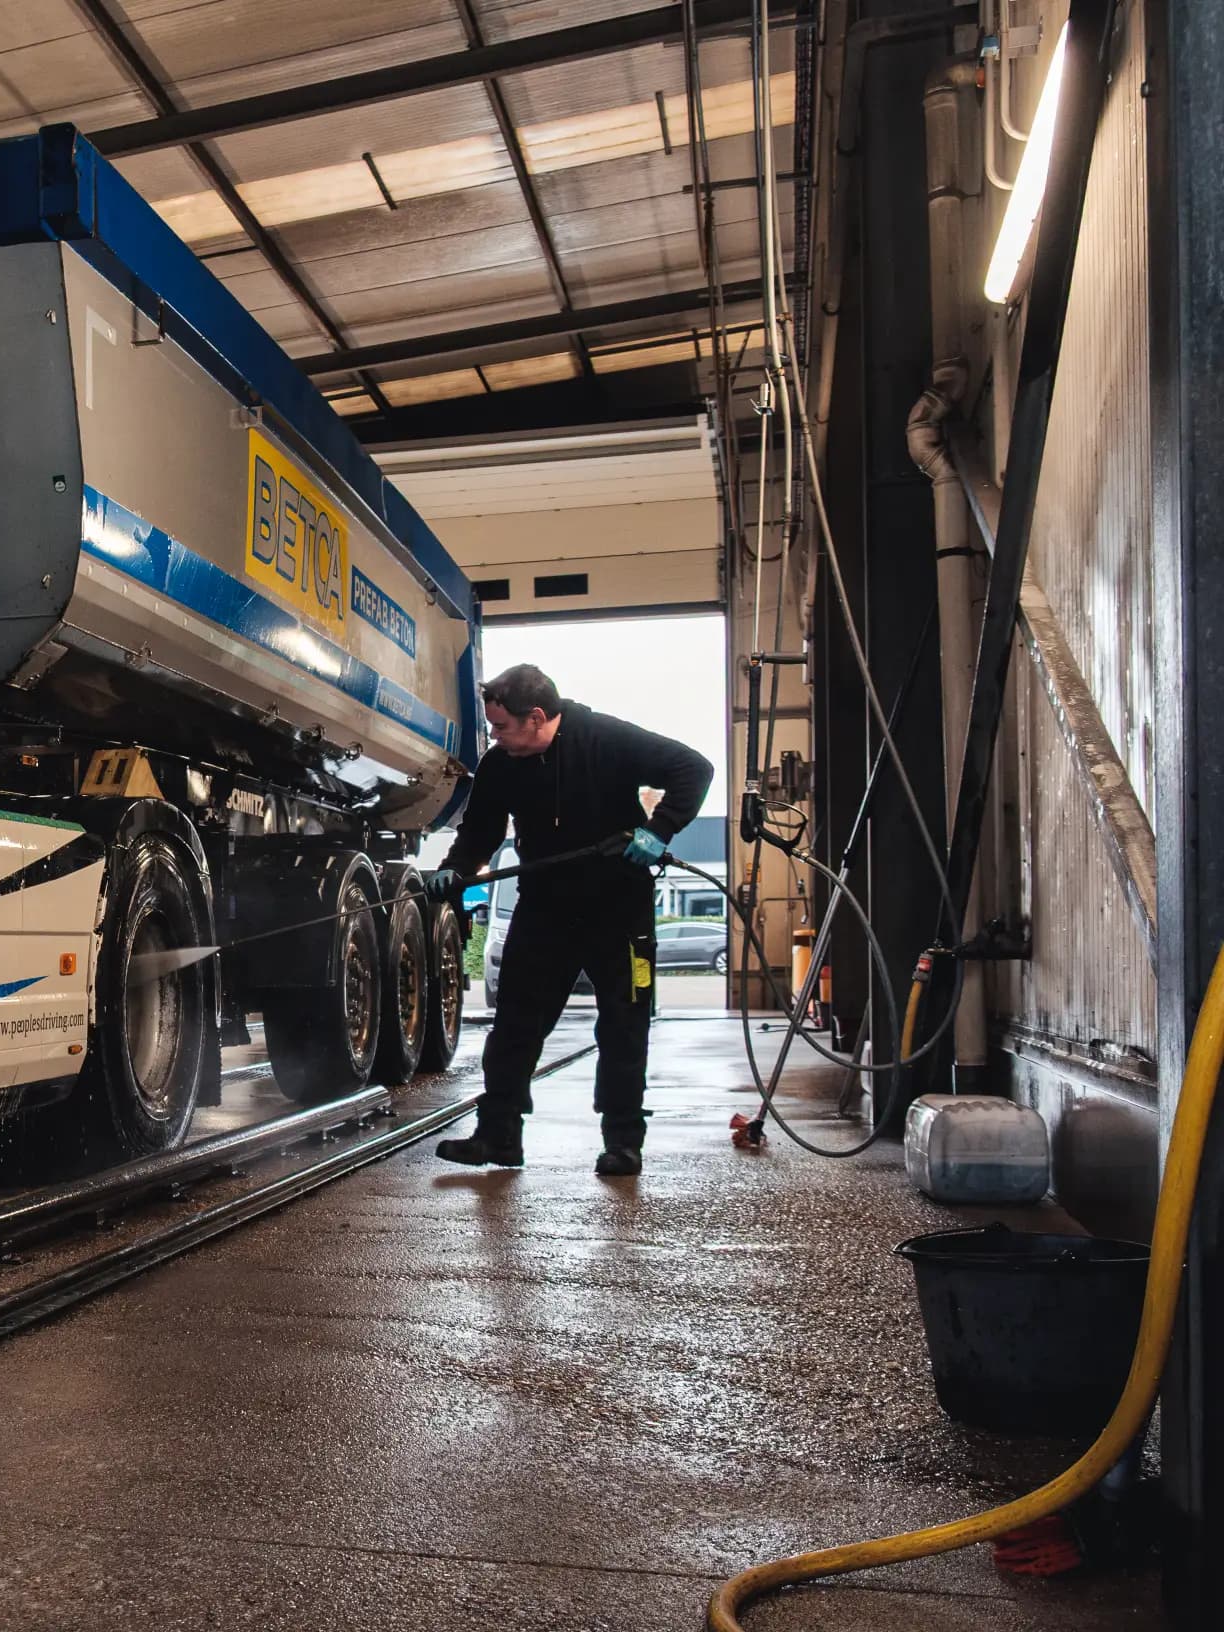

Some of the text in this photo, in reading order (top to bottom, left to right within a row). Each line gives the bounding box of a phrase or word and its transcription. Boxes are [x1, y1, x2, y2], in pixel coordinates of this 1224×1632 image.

[252, 454, 343, 620] BETCA
[354, 575, 414, 654] PREFAB BETON
